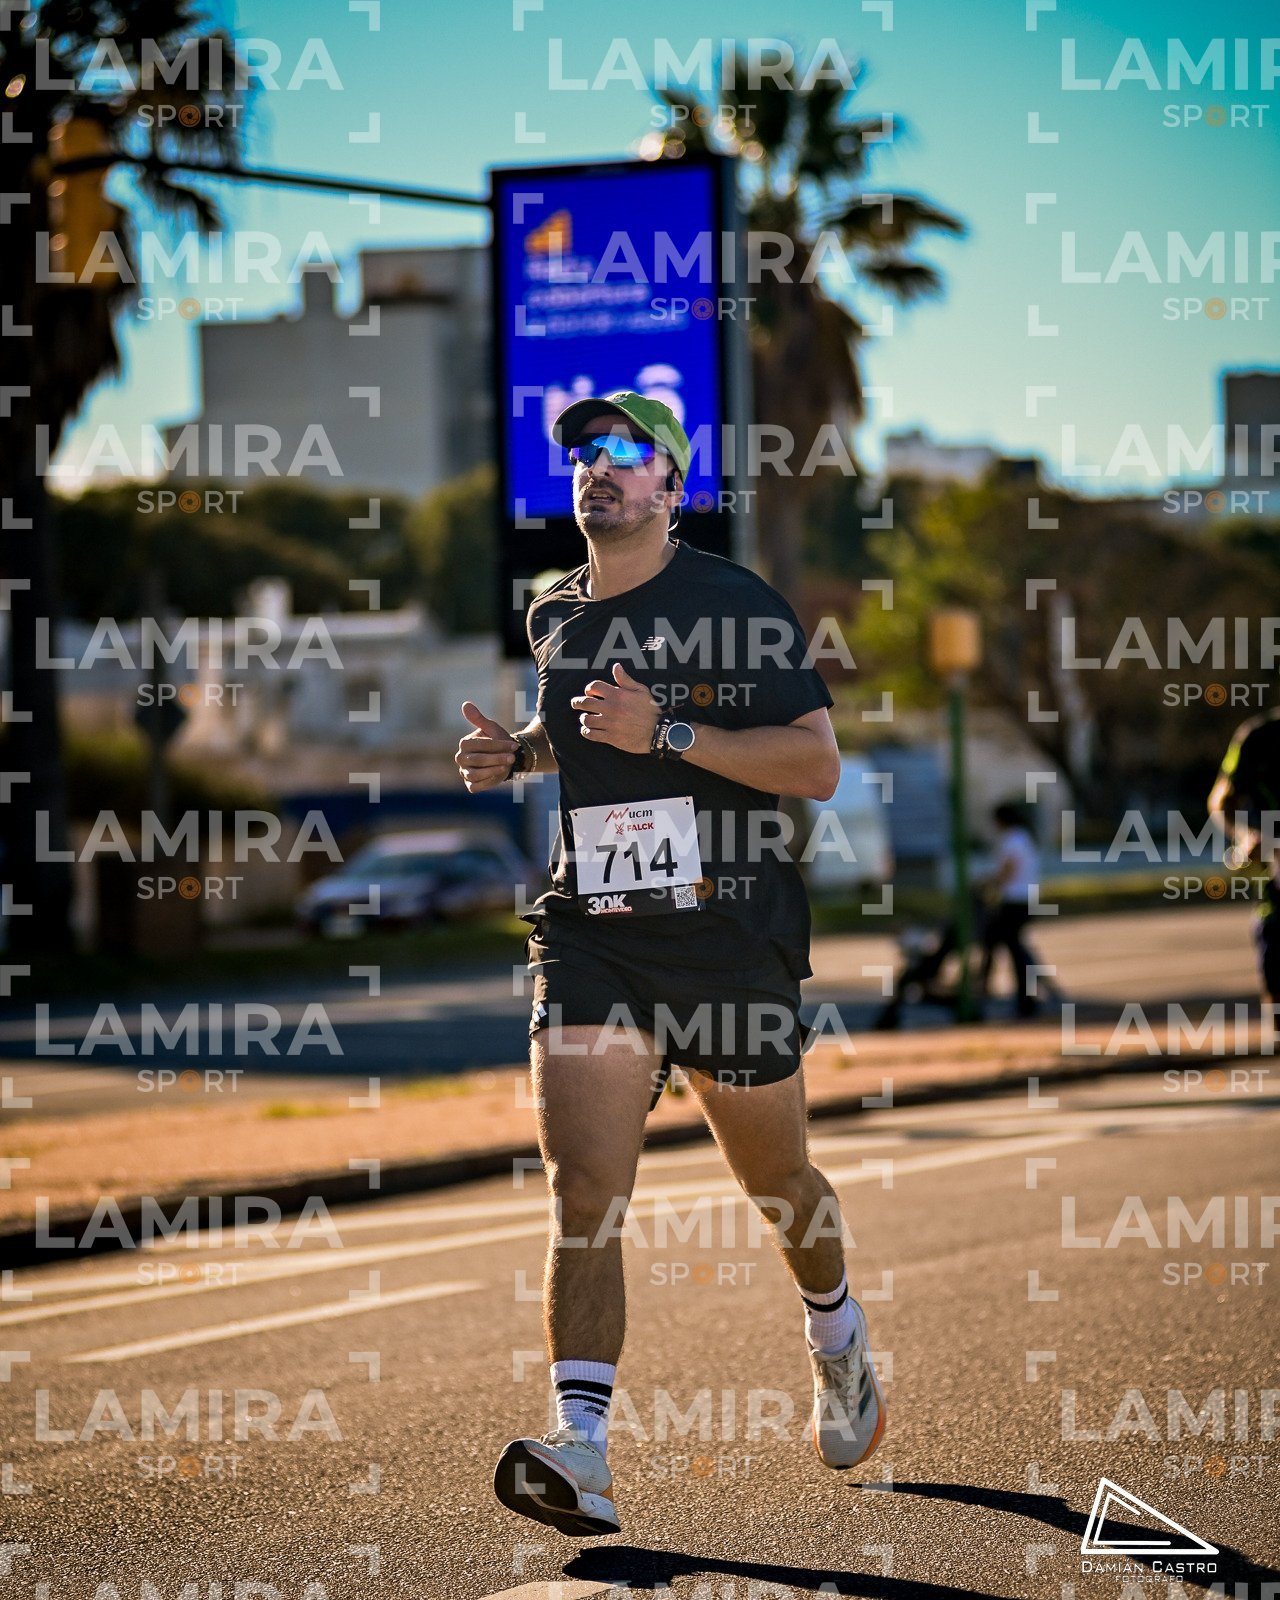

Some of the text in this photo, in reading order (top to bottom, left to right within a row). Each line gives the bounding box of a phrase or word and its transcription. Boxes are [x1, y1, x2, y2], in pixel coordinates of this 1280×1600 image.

[628, 810, 653, 819] ucm
[627, 822, 654, 832] FALCK
[595, 837, 679, 884] 714
[587, 893, 627, 915] 30K
